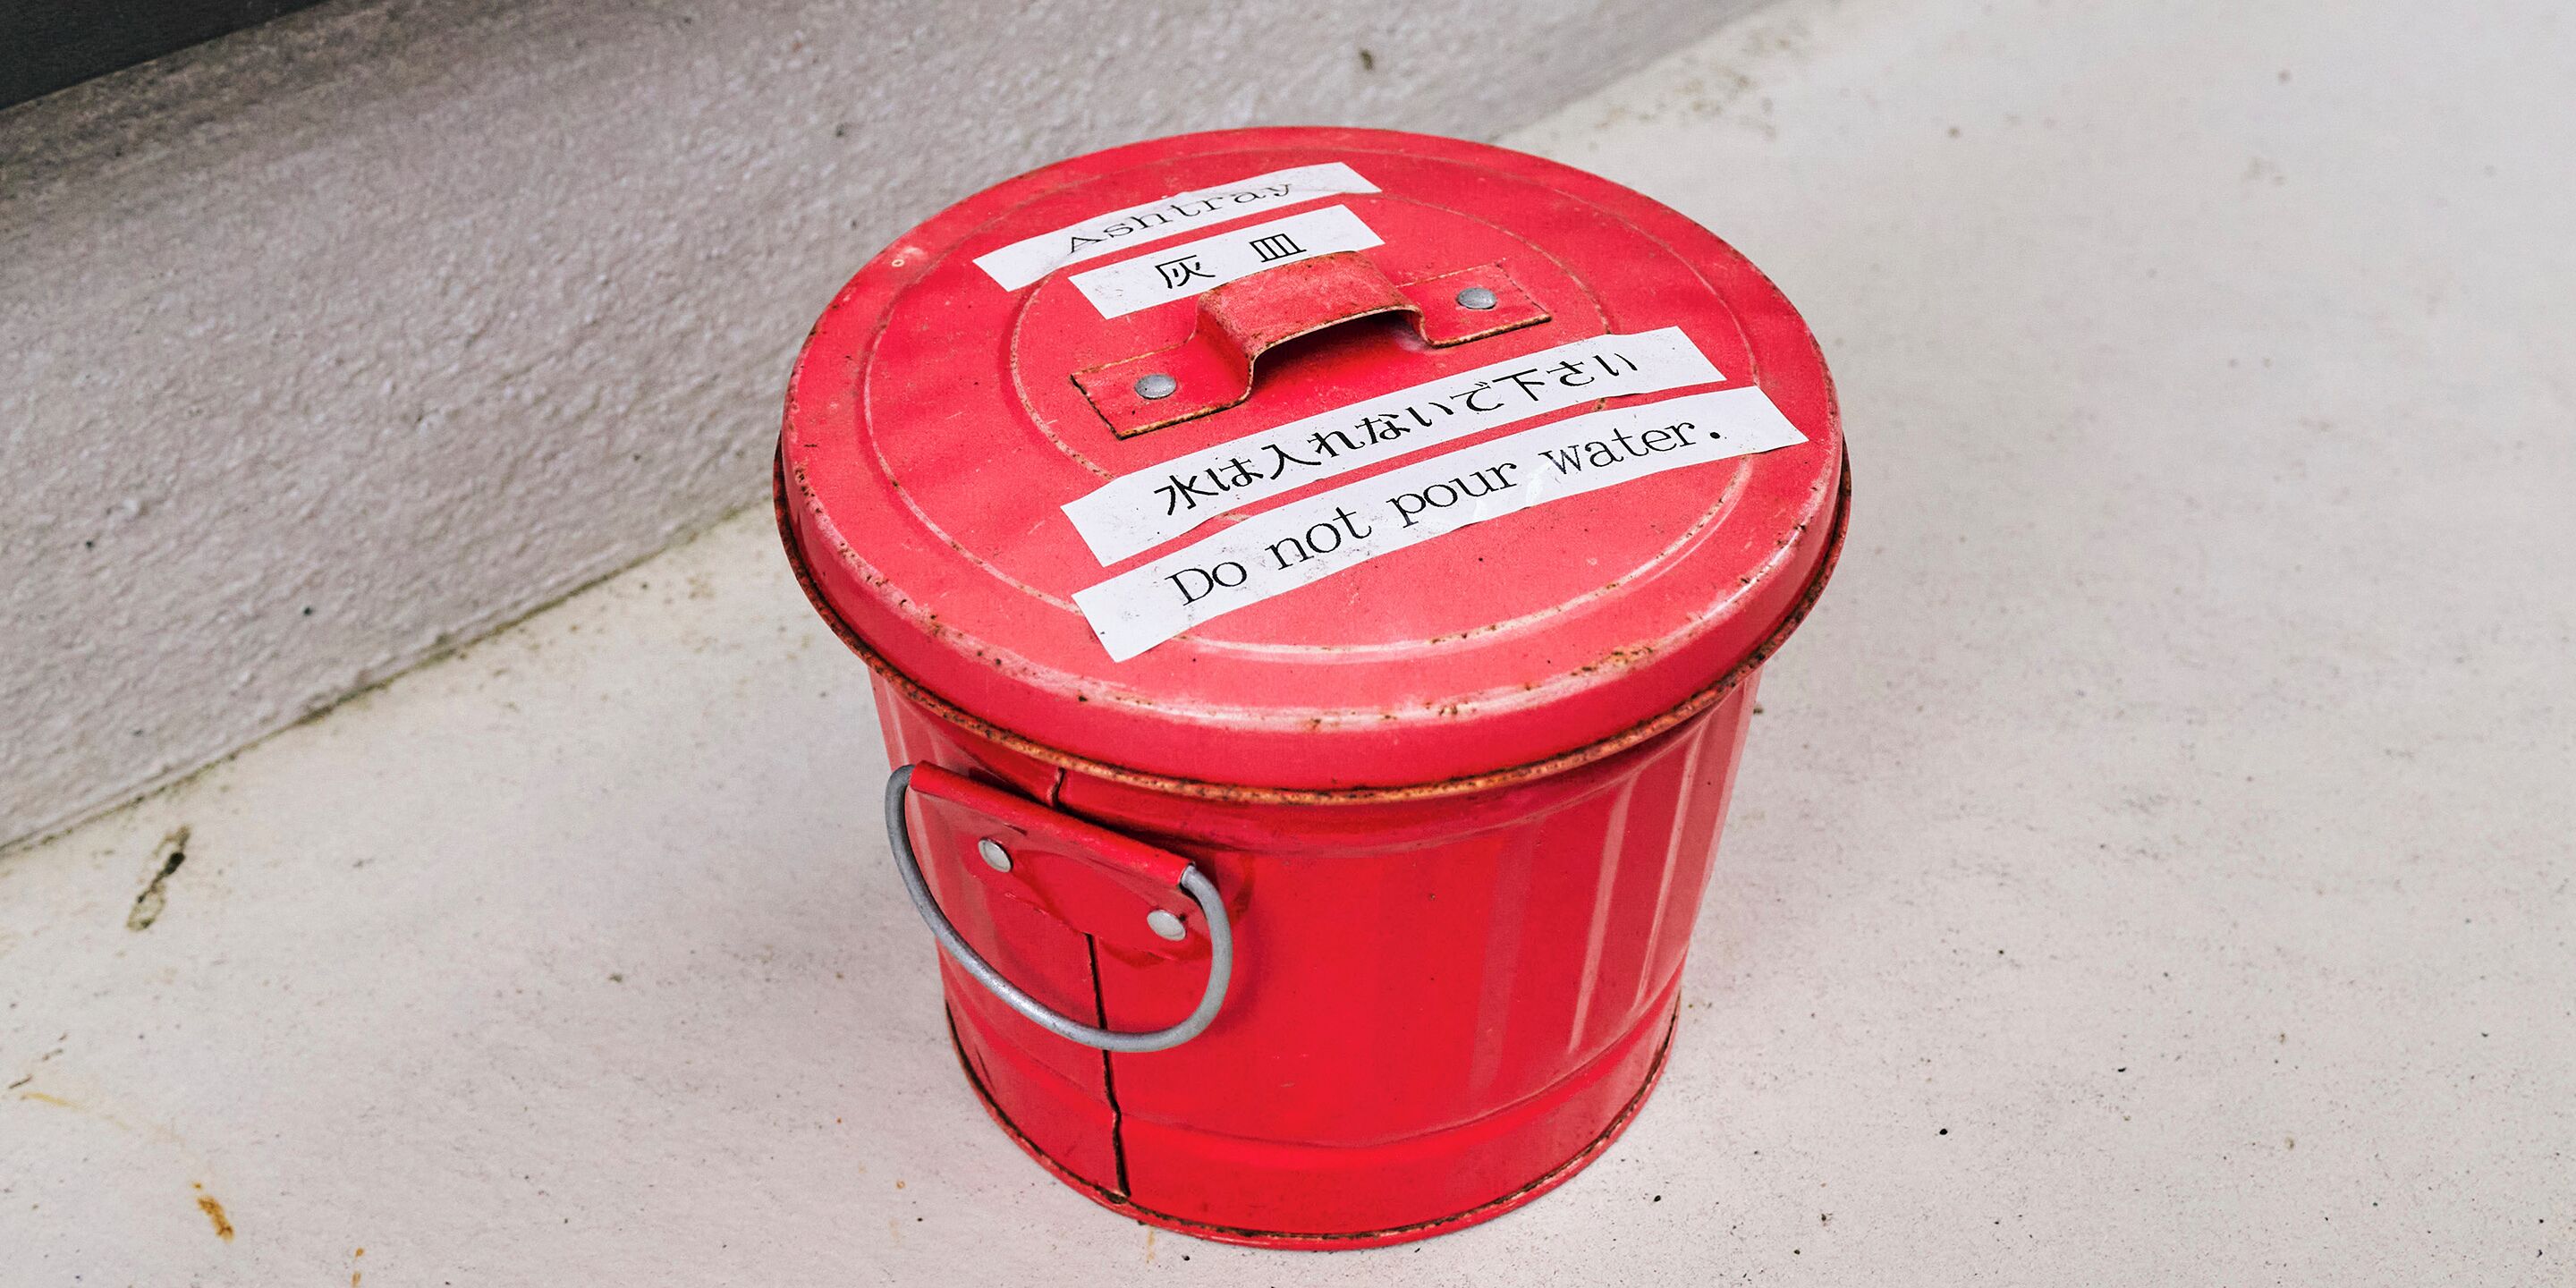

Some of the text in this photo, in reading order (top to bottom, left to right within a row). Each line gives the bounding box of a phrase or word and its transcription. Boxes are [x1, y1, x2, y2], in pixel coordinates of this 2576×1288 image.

[1067, 182, 1292, 254] Ashtray
[1153, 352, 1639, 516] 水は入れないで下さい
[1165, 420, 1723, 606] Do not pour water.
